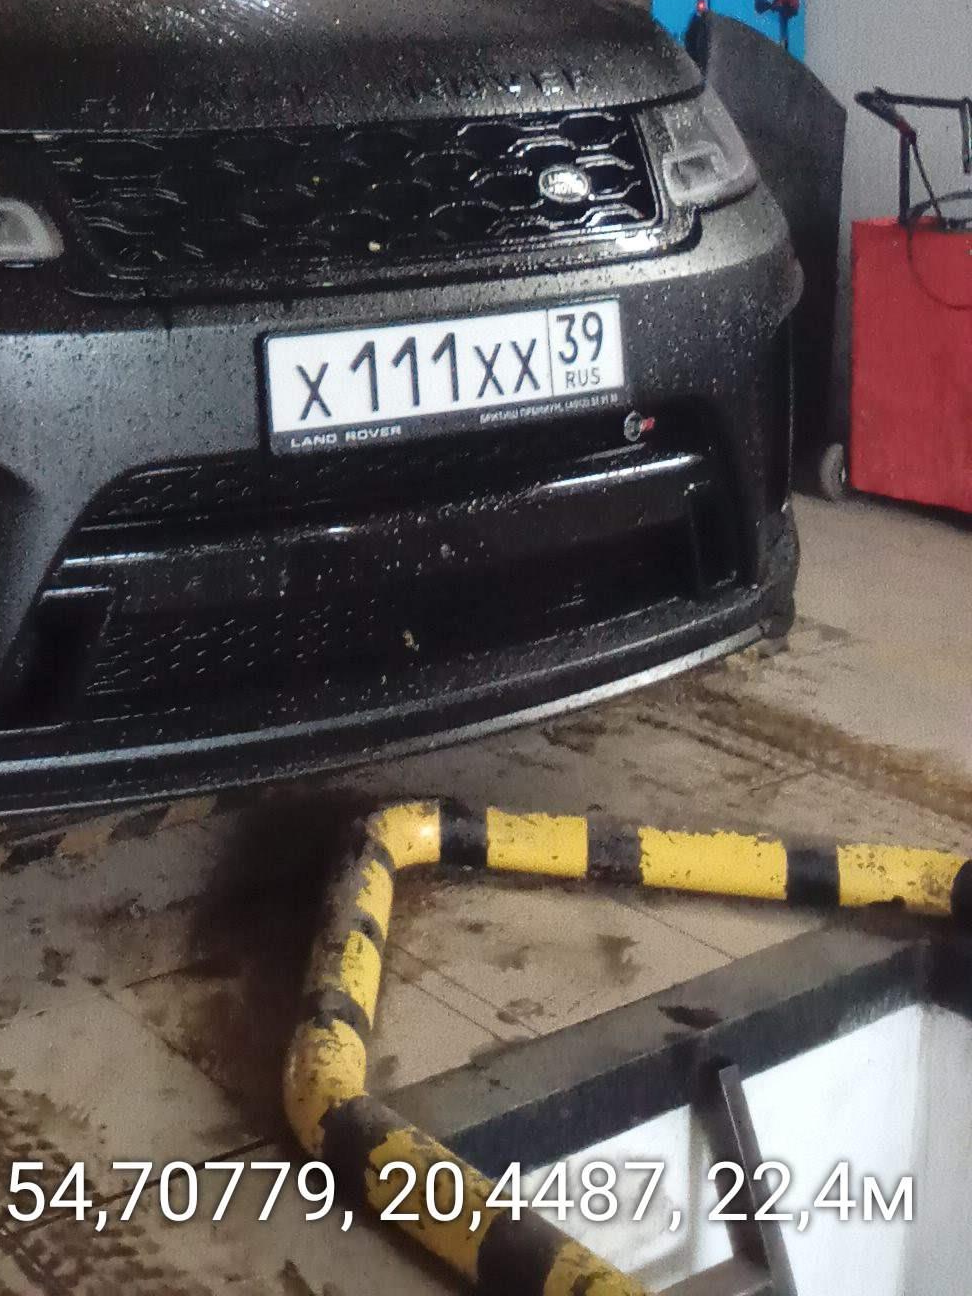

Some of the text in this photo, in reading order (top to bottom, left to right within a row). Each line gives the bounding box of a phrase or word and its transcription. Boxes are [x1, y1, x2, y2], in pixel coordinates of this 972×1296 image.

[555, 310, 605, 365] 39
[564, 366, 601, 387] RUS
[290, 424, 403, 449] LAND ROVER
